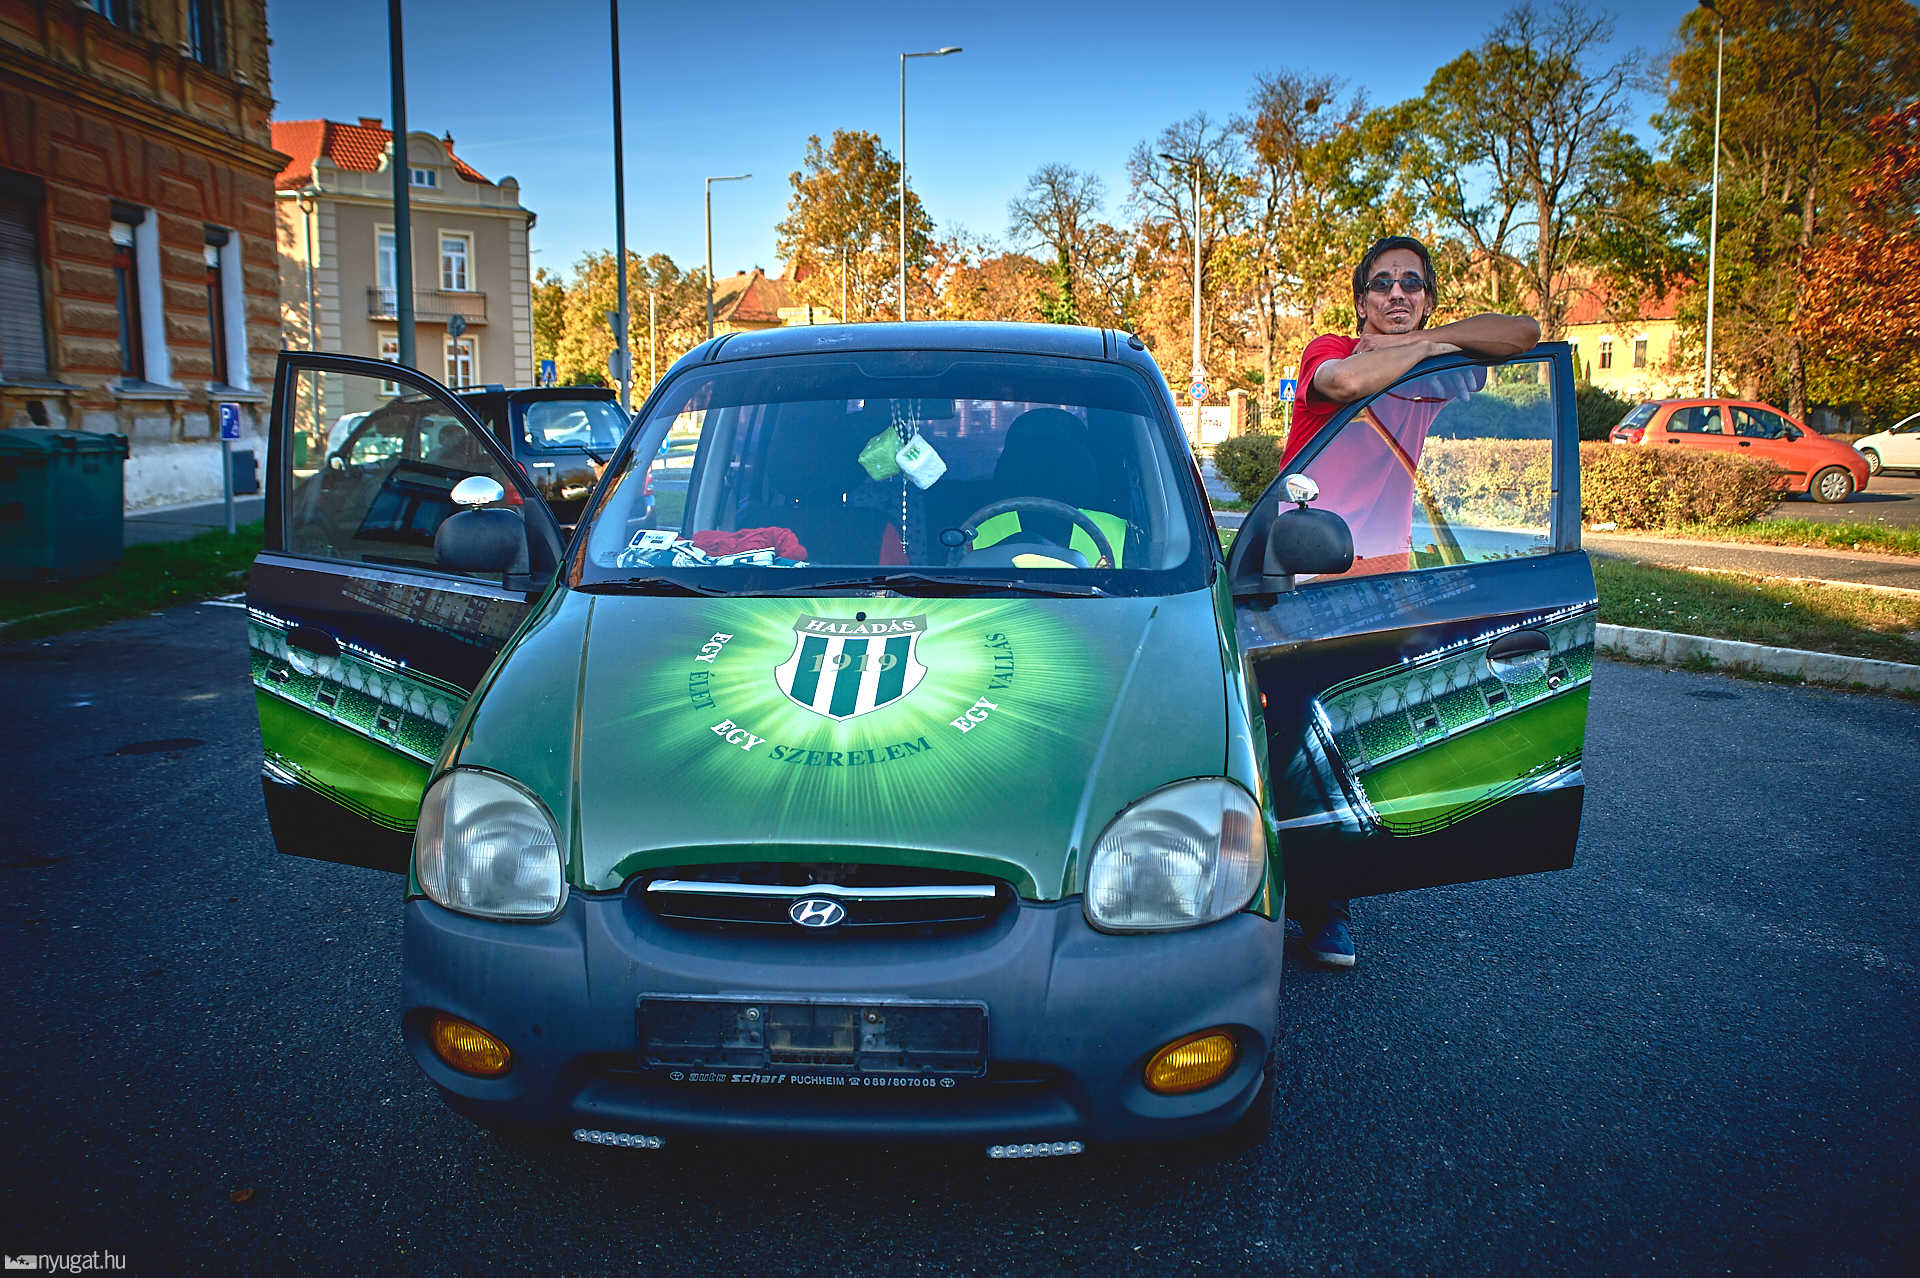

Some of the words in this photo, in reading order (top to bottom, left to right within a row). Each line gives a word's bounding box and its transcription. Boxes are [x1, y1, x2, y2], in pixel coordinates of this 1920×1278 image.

[221, 407, 231, 426] P
[805, 619, 917, 634] HALADÁS
[695, 632, 734, 664] EGY
[808, 653, 898, 673] 1919
[689, 670, 716, 710] ÉLET
[949, 696, 999, 734] EGY
[984, 632, 1015, 690] VALLÁS
[710, 718, 767, 752] EGY
[768, 735, 933, 767] SZERELEM
[791, 1075, 845, 1086] PUCHHEIM
